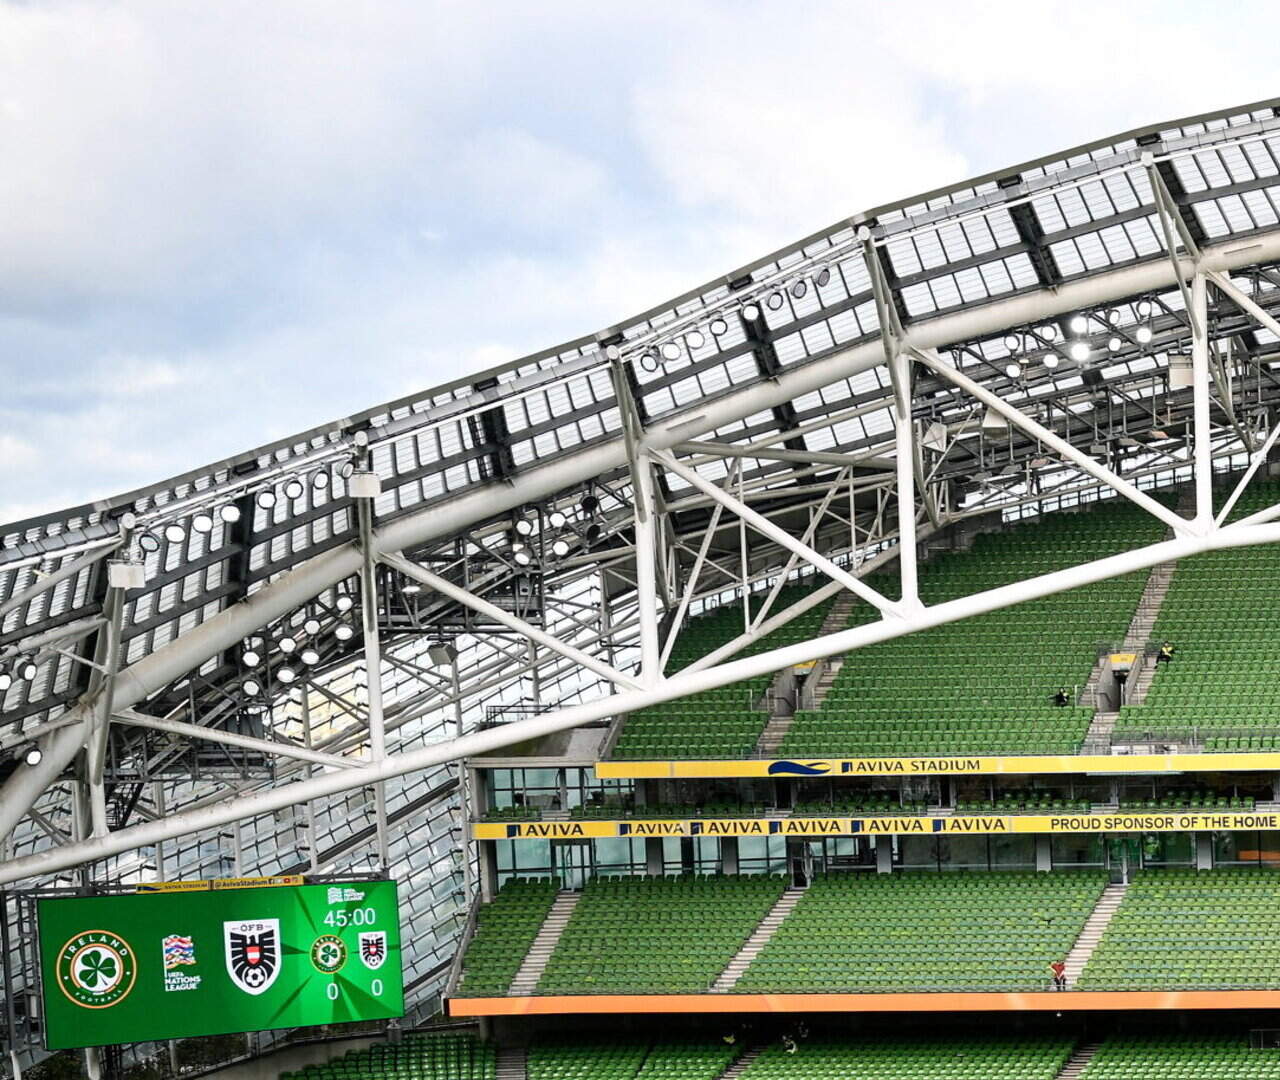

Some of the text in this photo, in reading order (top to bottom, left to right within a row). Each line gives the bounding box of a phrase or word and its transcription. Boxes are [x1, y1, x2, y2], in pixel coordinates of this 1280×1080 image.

[857, 760, 979, 771] AVIVA STADIUM
[708, 822, 762, 833] AVIVA
[787, 821, 840, 832] AVIVA
[869, 820, 923, 831] AVIVA
[951, 819, 1005, 830] AVIVA
[1051, 818, 1101, 829] PROUD
[1105, 817, 1173, 829] SPONSOR
[1180, 817, 1198, 828] OF
[1202, 817, 1230, 828] THE
[1234, 816, 1276, 827] HOME
[526, 824, 583, 836] AVIVA
[636, 824, 684, 834] AVIVA
[324, 907, 376, 927] 45:00
[64, 935, 128, 960] IRELAND
[165, 975, 201, 984] NATIONS
[165, 983, 198, 992] LEAGUE
[327, 983, 339, 1000] 0
[370, 979, 383, 996] 0
